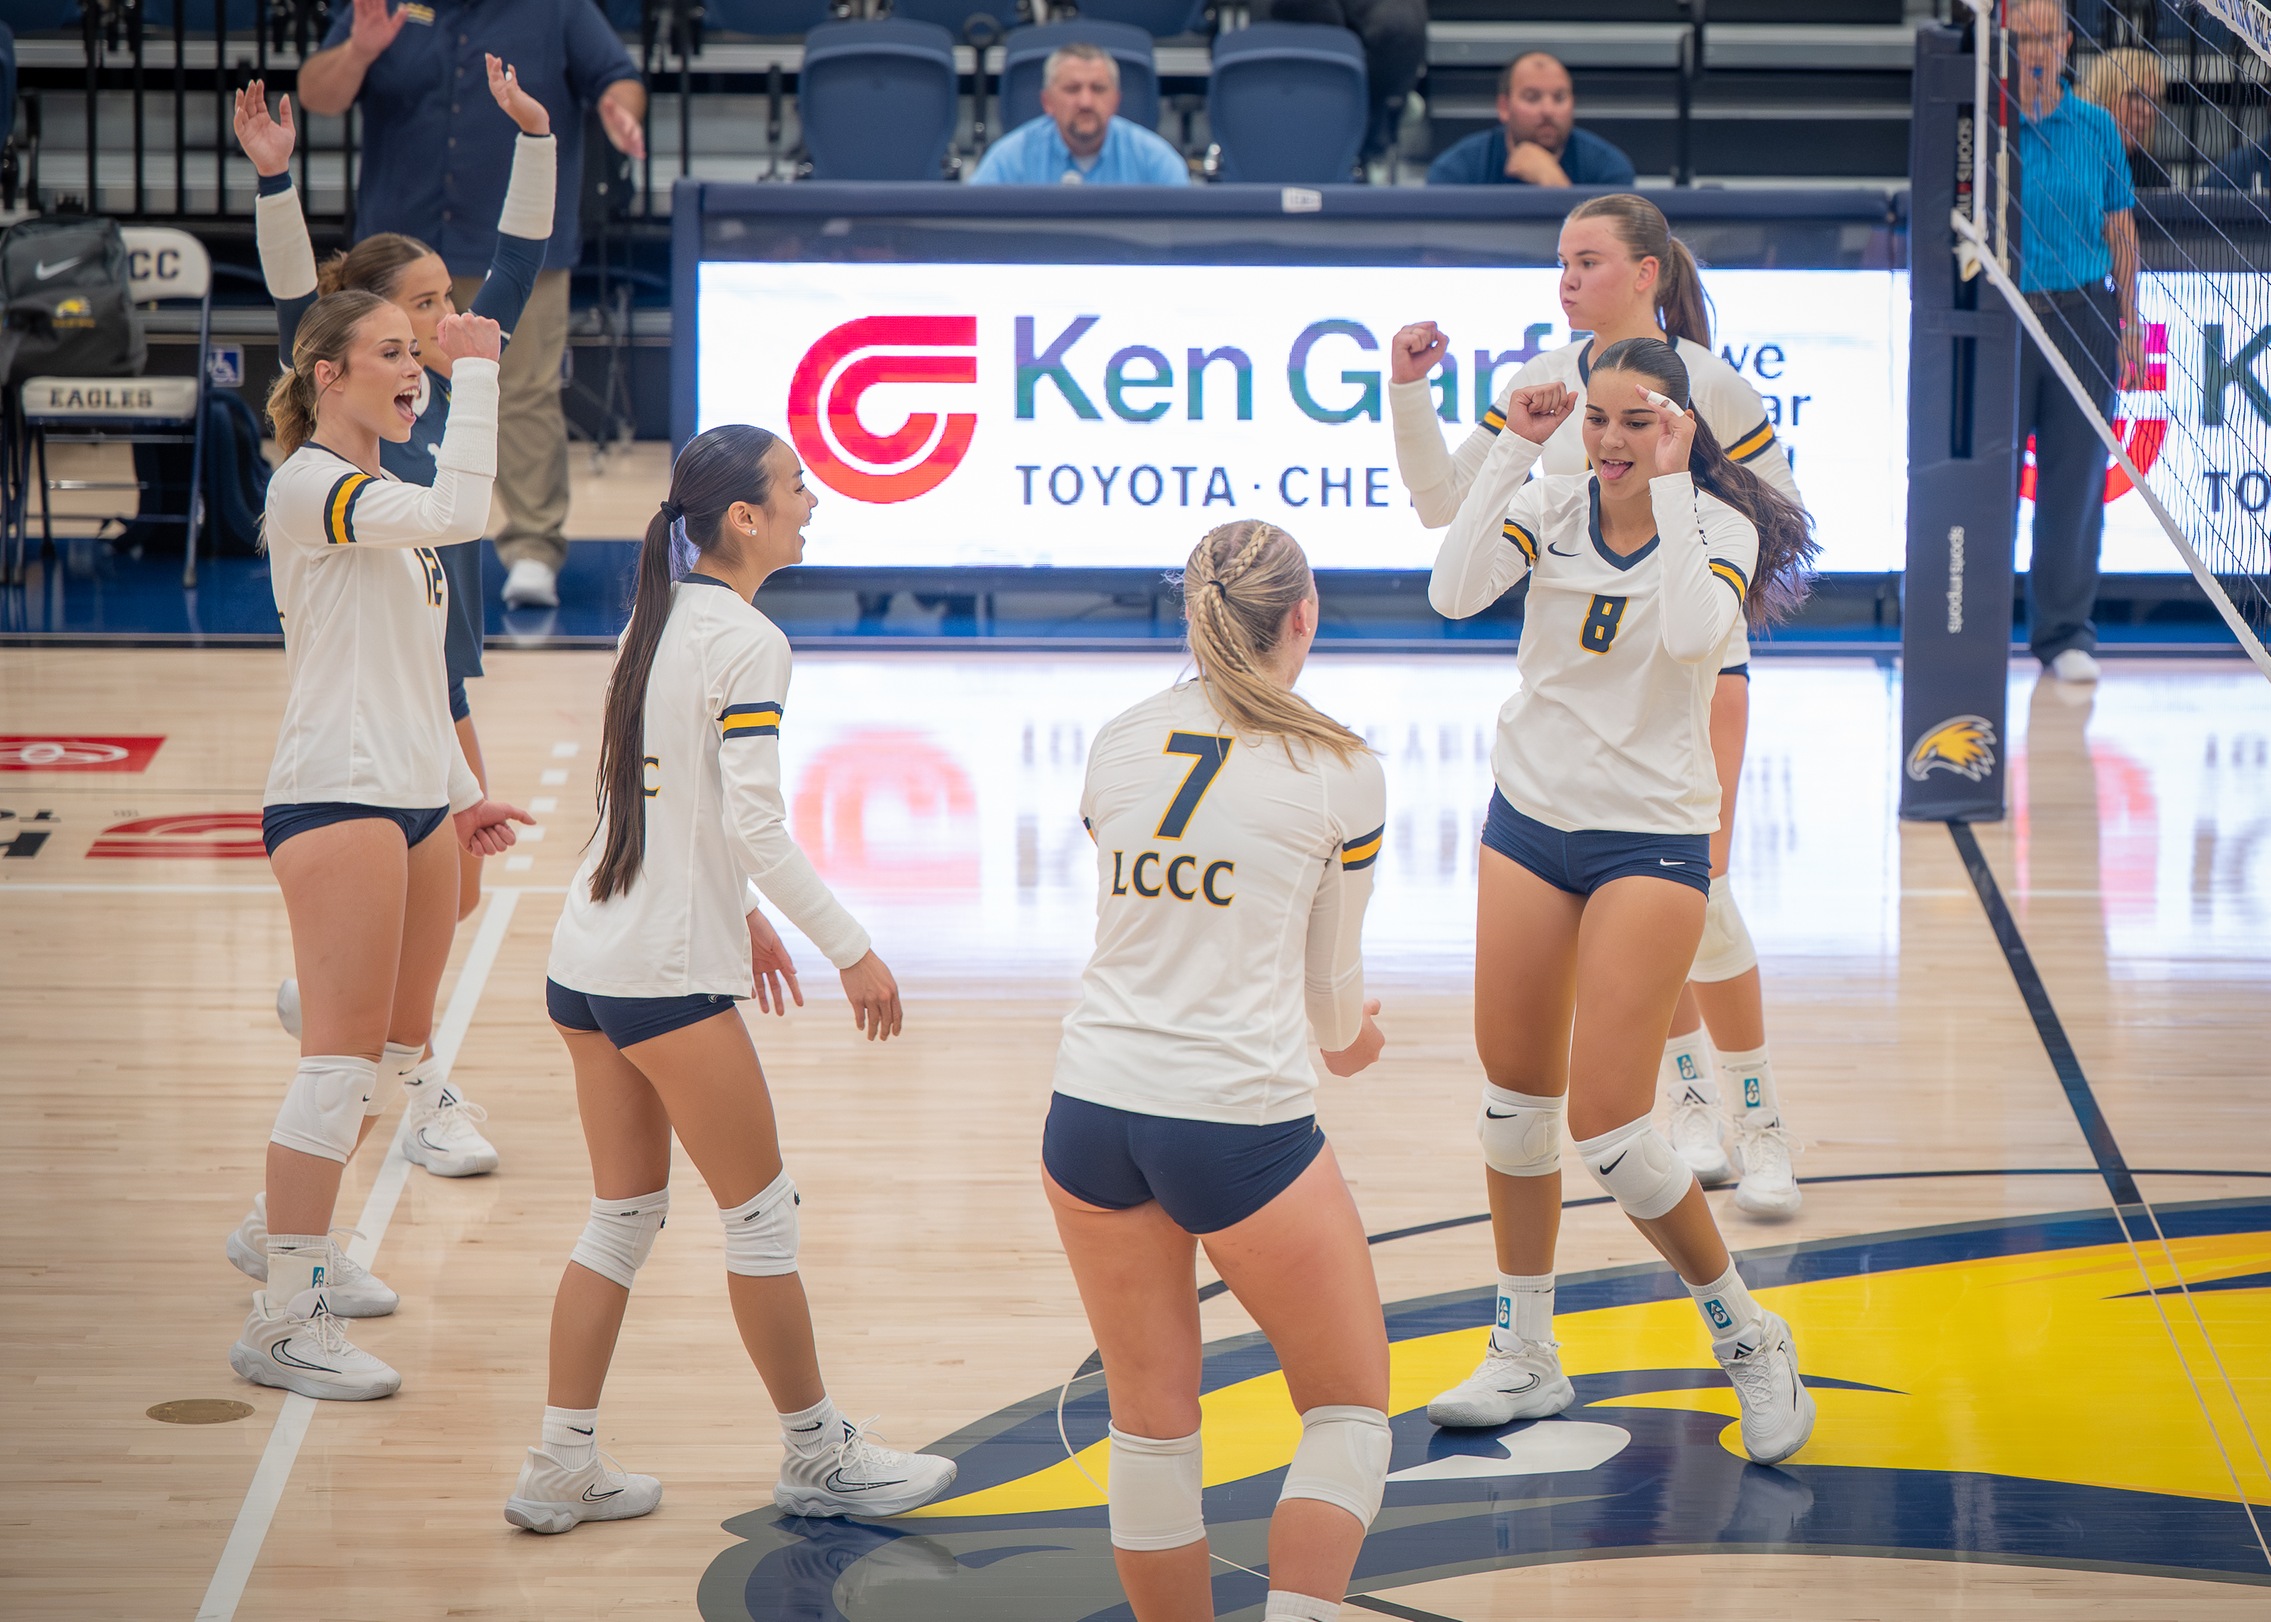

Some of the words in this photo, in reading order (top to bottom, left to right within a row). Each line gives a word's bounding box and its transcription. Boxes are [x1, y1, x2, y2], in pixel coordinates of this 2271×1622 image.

[49, 388, 153, 409] EAGLES
[1014, 314, 1254, 424] Ken
[1287, 318, 1594, 426] Garf
[1015, 464, 1238, 507] TOYOTA
[1279, 465, 1390, 508] CHE
[2203, 472, 2270, 513] TO
[1579, 593, 1631, 656] 8
[1153, 730, 1236, 842] 7
[1111, 850, 1236, 909] LCCC
